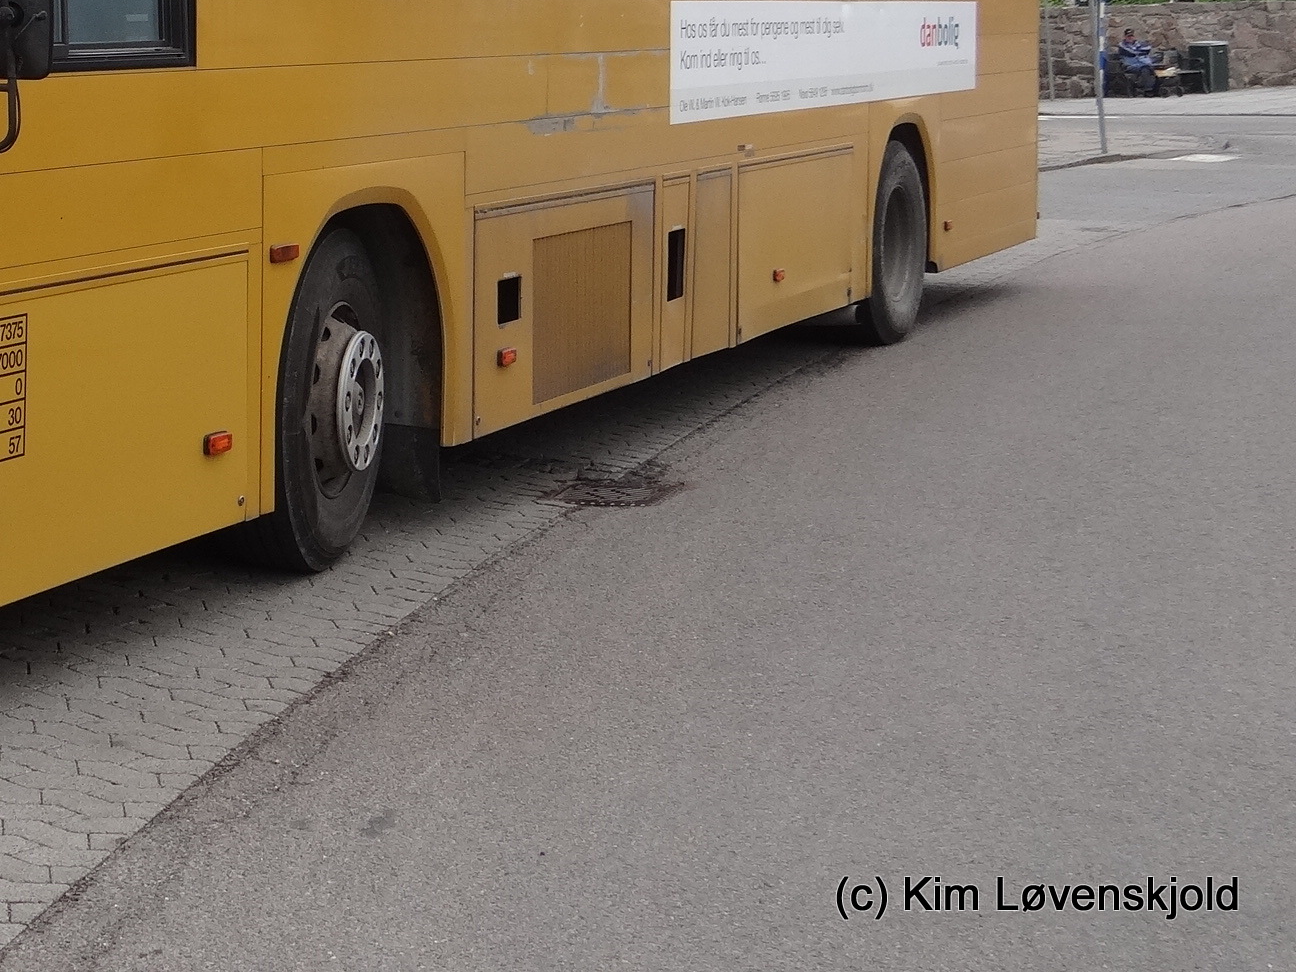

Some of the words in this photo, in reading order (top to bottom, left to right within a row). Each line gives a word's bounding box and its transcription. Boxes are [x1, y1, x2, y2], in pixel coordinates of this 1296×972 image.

[680, 19, 696, 39] Hos
[919, 16, 960, 50] danbolig
[680, 50, 699, 70] Kom
[15, 377, 23, 396] 0
[8, 406, 22, 427] 30
[8, 435, 21, 455] 57
